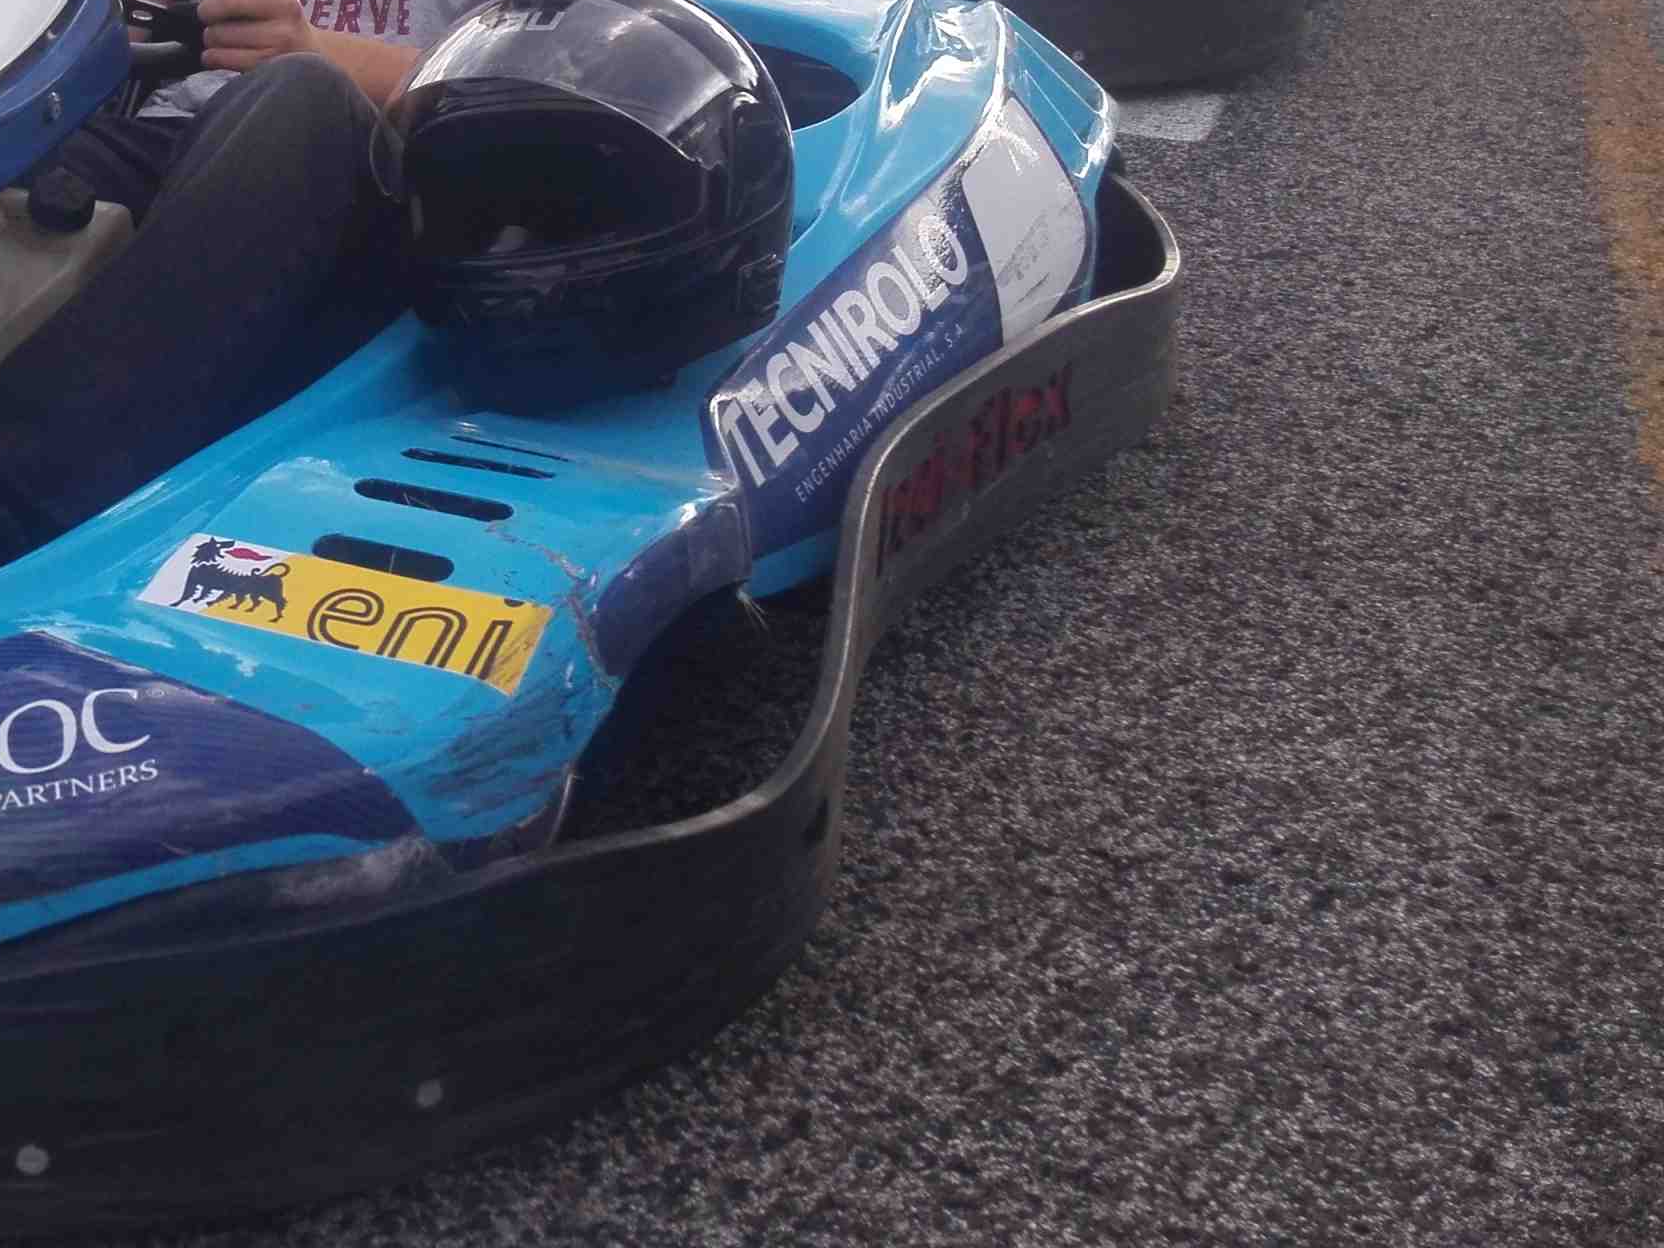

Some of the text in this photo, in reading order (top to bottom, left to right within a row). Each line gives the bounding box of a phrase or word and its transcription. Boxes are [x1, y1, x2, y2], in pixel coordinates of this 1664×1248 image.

[715, 215, 968, 488] TECNIROLO
[794, 417, 873, 503] ENGENHARIA
[305, 588, 526, 681] eni
